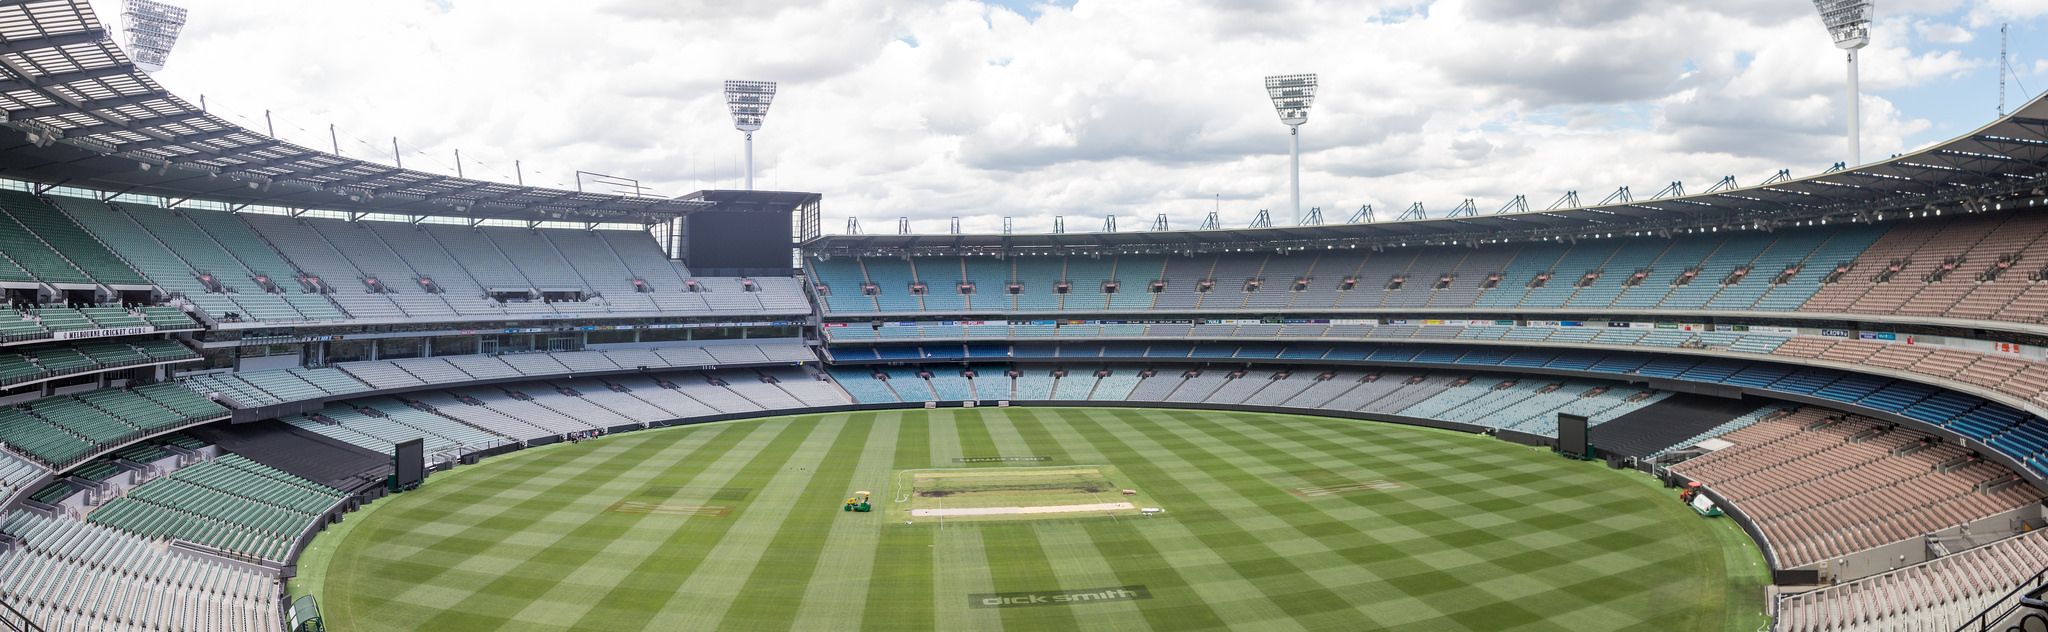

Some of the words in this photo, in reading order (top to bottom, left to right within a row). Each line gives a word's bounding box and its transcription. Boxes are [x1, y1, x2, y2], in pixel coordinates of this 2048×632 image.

[746, 133, 752, 141] 2
[69, 329, 100, 339] MELBOURNE
[102, 328, 126, 337] CRICKET
[128, 327, 141, 335] CLUB
[983, 594, 1048, 605] dick
[1054, 589, 1137, 602] smith
